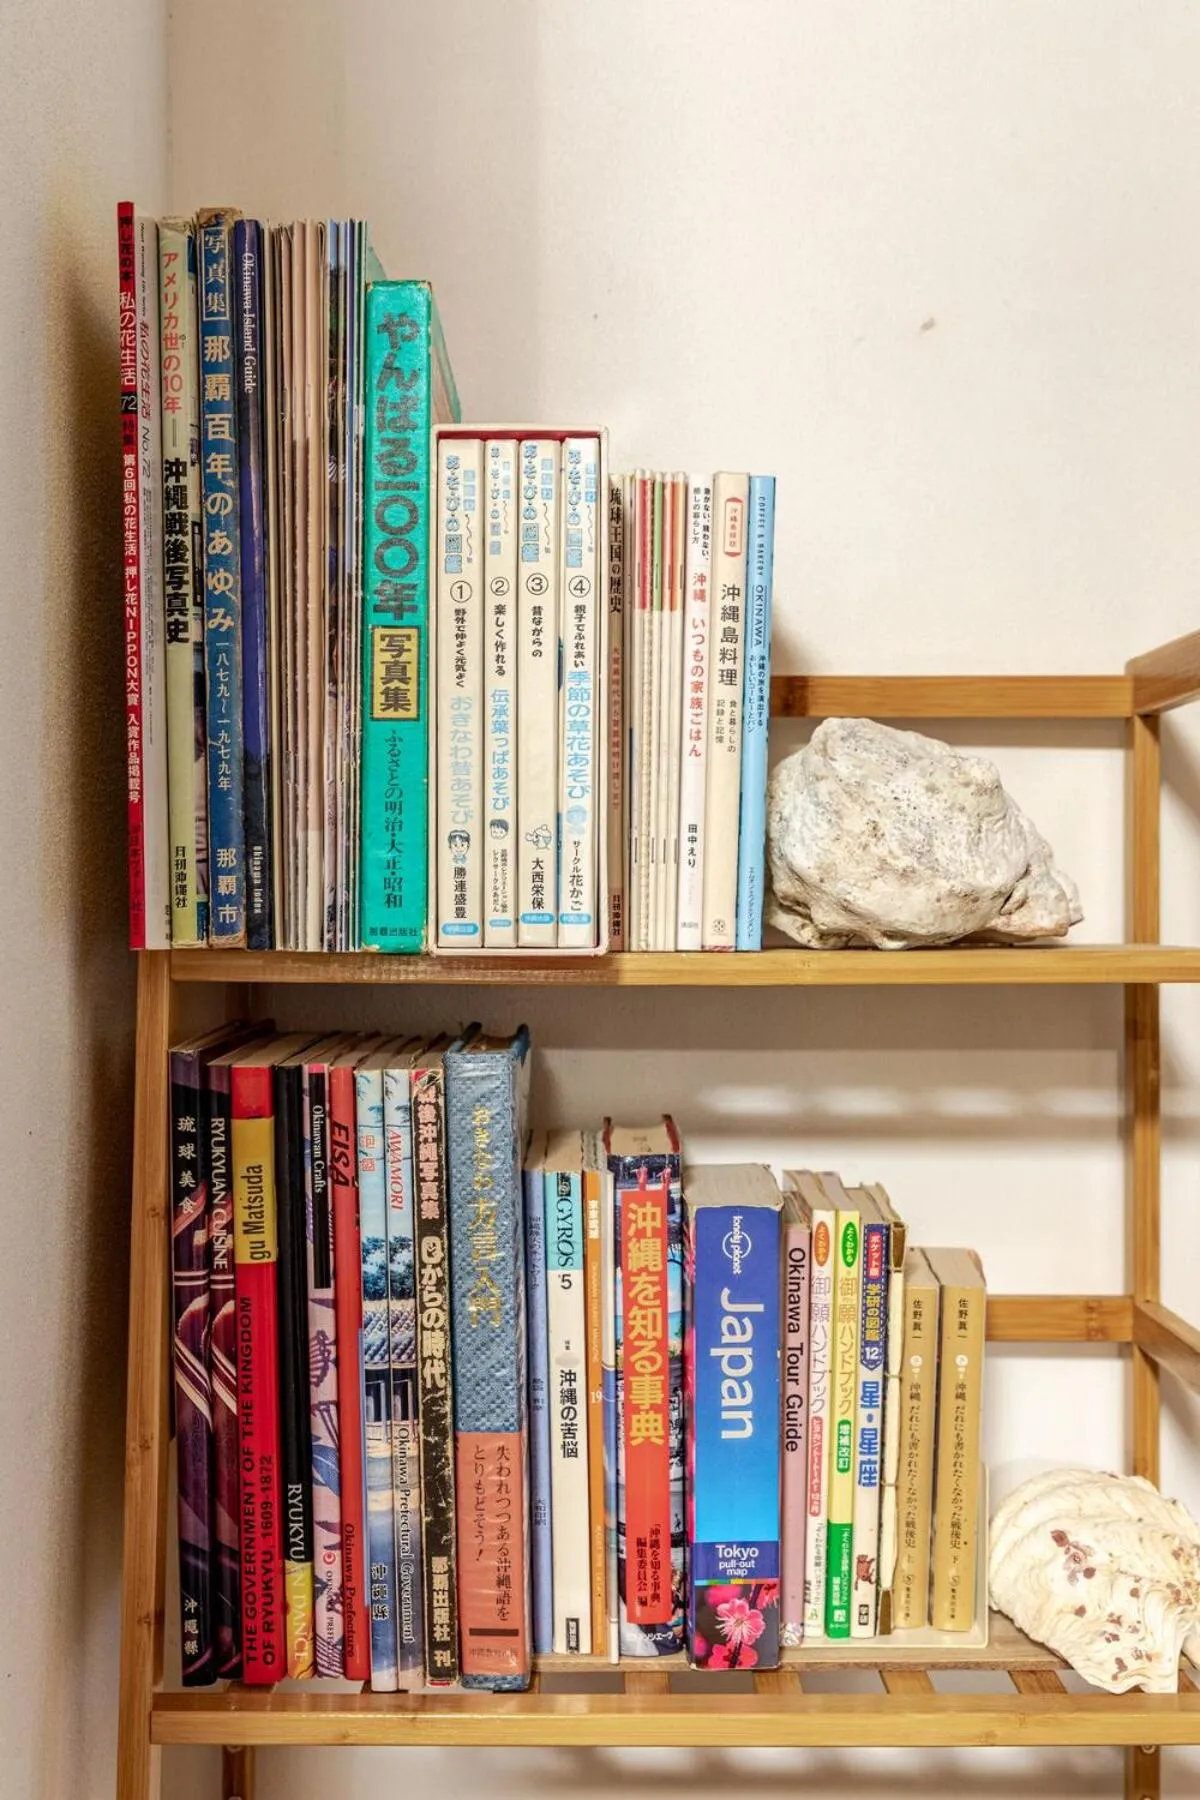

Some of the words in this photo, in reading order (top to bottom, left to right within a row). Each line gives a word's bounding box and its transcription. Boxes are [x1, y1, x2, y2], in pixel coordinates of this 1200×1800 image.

[204, 233, 227, 315] 写真集
[243, 252, 256, 309] Okinawa
[119, 292, 137, 386] 私の花生活
[163, 252, 183, 414] アメリカ世の10年
[244, 313, 256, 352] Island
[121, 396, 137, 410] 72
[244, 356, 257, 394] Guide
[142, 426, 151, 478] No.72
[374, 312, 421, 622] やんばる100年
[203, 335, 236, 634] 那覇百年のあゆみ
[757, 496, 766, 528] COFFEE
[610, 487, 622, 613] 琉球王国の歴史
[756, 543, 764, 576] BAKERY
[693, 572, 707, 603] 沖縄
[754, 584, 765, 647] OKINAWA
[493, 604, 507, 677] 楽しく作れる
[531, 605, 545, 658] 昔ながらの
[574, 604, 587, 668] 親子でふれあい
[717, 584, 741, 687] 沖縄島料理
[379, 633, 412, 713] 写真集
[688, 617, 706, 758] いつもの家族ごはん
[491, 689, 510, 812] 伝承葉っぱあそび
[567, 671, 592, 800] 季節の草花あそび
[727, 699, 738, 753] 食と暮らしの
[569, 840, 584, 912] サークル花かご
[688, 823, 698, 868] 田中えり
[216, 848, 237, 924] 那覇市
[453, 866, 468, 919] 勝連盛豊
[531, 857, 545, 911] 大西栄保
[210, 1117, 227, 1205] RYUKYUAN
[312, 1104, 324, 1159] Okinawan
[330, 1119, 350, 1187] EISA
[240, 1163, 265, 1235] Matsuda
[314, 1160, 327, 1194] Crafts
[388, 1129, 404, 1211] AWAMORI
[211, 1207, 229, 1270] CUISINE
[556, 1198, 574, 1268] GYROS
[730, 1215, 744, 1243] lonely
[730, 1244, 744, 1275] planet
[559, 1274, 572, 1290] 5
[787, 1247, 807, 1335] Okinawa
[239, 1296, 253, 1394] KINGDOM
[627, 1201, 665, 1446] 沖縄を知る事典
[810, 1275, 831, 1415] 御願ハンドブック
[838, 1275, 858, 1416] 御願ハンドブック
[864, 1346, 880, 1361] 12
[709, 1286, 765, 1440] Japan
[786, 1342, 804, 1387] Tour
[909, 1382, 921, 1402] 沖縄
[954, 1382, 967, 1402] 沖縄
[241, 1401, 254, 1439] THE
[559, 1369, 579, 1459] 沖縄の苦悩
[591, 1391, 603, 1404] 19
[785, 1393, 804, 1453] Guide
[242, 1447, 255, 1472] OF
[397, 1426, 410, 1485] Okinawa
[858, 1381, 881, 1488] 星・星座
[259, 1455, 274, 1539] 1609-1872
[905, 1406, 920, 1549] だれにも書かれたくなかった戦後史
[950, 1406, 966, 1550] だれにも書かれたくなかった戦後史
[242, 1480, 257, 1621] GOVERNMENT
[287, 1483, 306, 1588] RYUKYUAN
[343, 1523, 356, 1584] Okinawa
[636, 1537, 648, 1592] 編集委員会
[715, 1544, 760, 1561] Tokyo
[718, 1559, 756, 1571] pull-out
[260, 1545, 276, 1632] RYUKYU,
[401, 1558, 415, 1643] Government
[726, 1567, 748, 1578] map
[243, 1628, 258, 1664] THE
[261, 1638, 276, 1665] OF
[292, 1593, 306, 1662] DANCE
[345, 1586, 356, 1658] Prefecture
[434, 1651, 451, 1668] 刊
